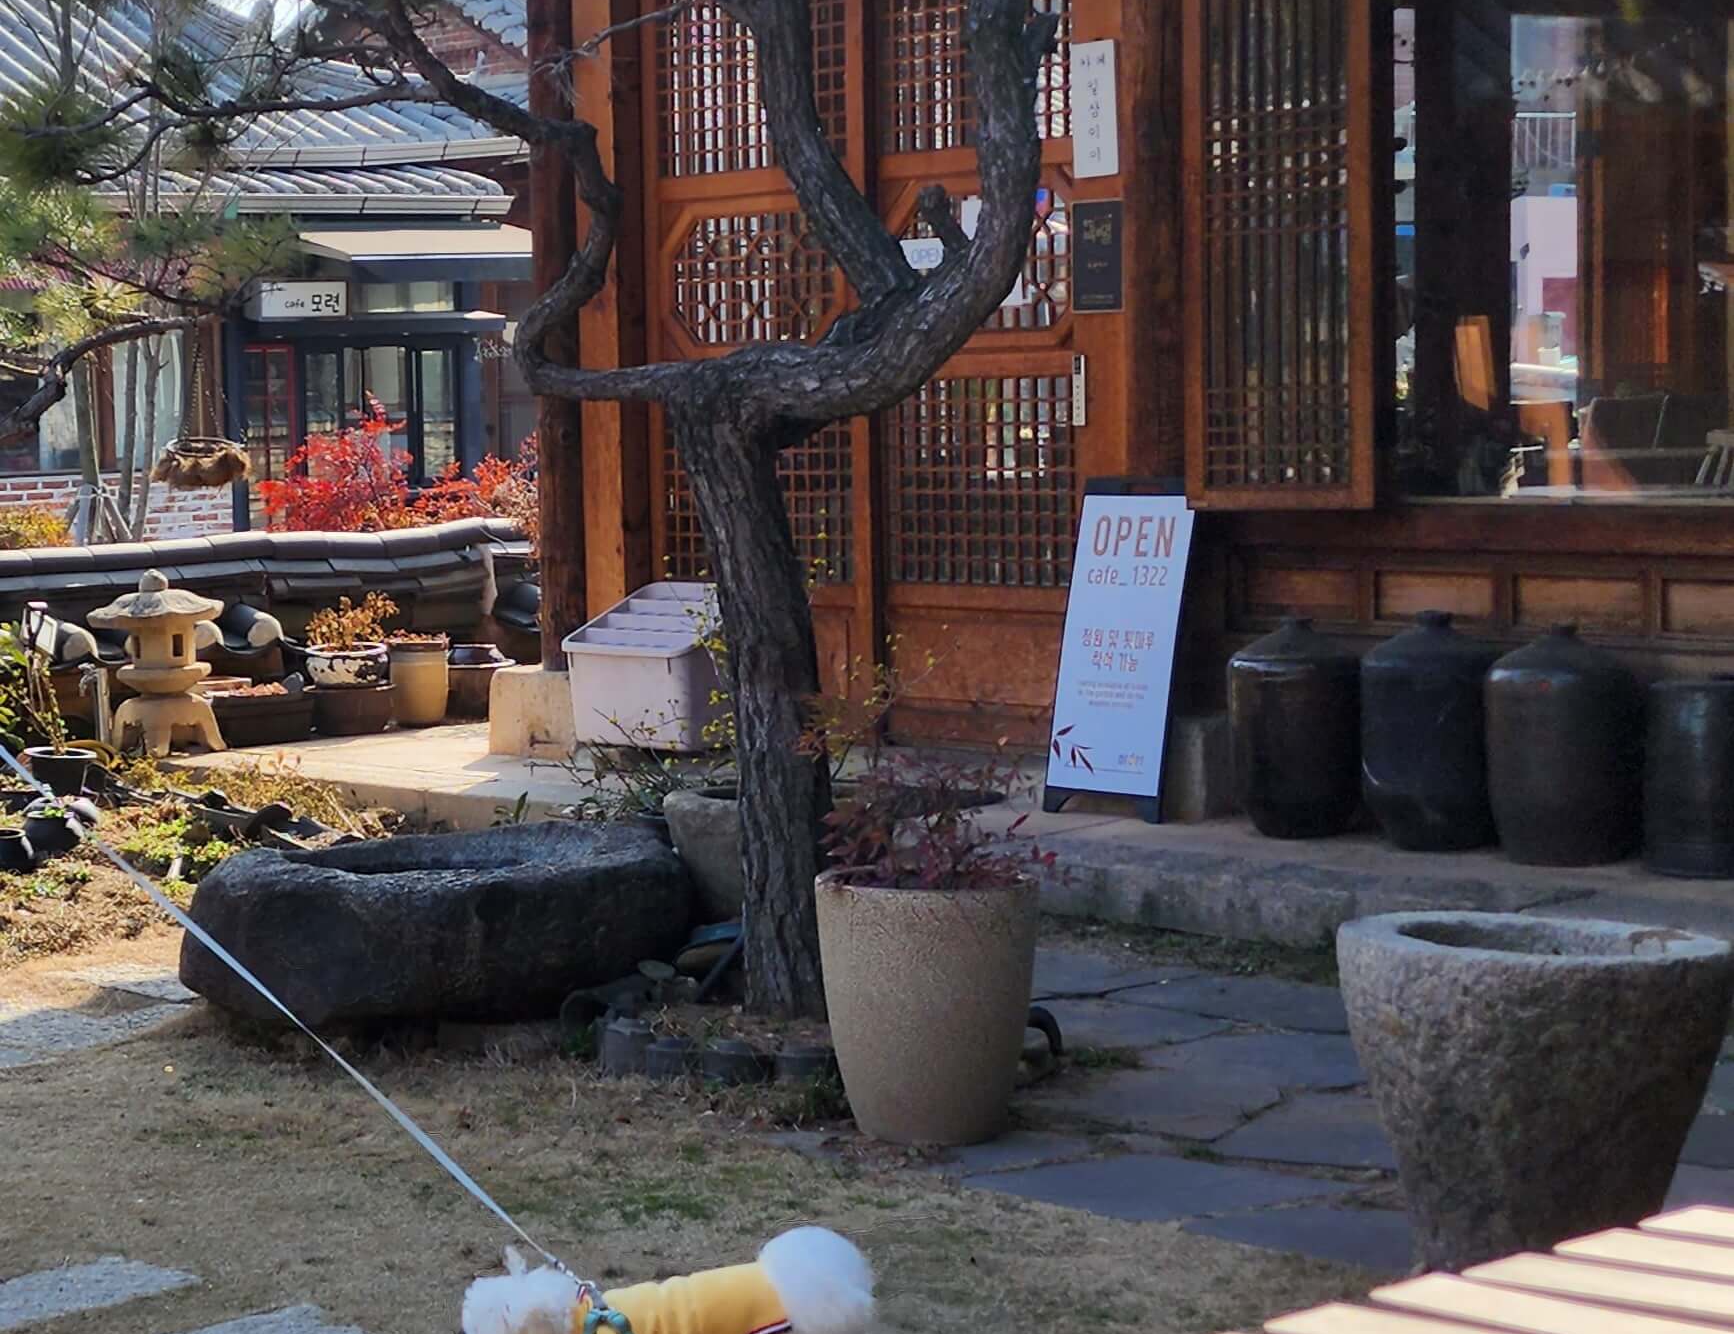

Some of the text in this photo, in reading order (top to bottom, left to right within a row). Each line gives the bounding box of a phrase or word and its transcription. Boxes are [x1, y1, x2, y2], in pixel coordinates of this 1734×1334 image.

[285, 293, 340, 313] cafe 모련
[1093, 514, 1177, 558] OPEN
[1081, 628, 1104, 648] 정원
[1108, 628, 1120, 649] 및
[1119, 651, 1138, 673] 가능
